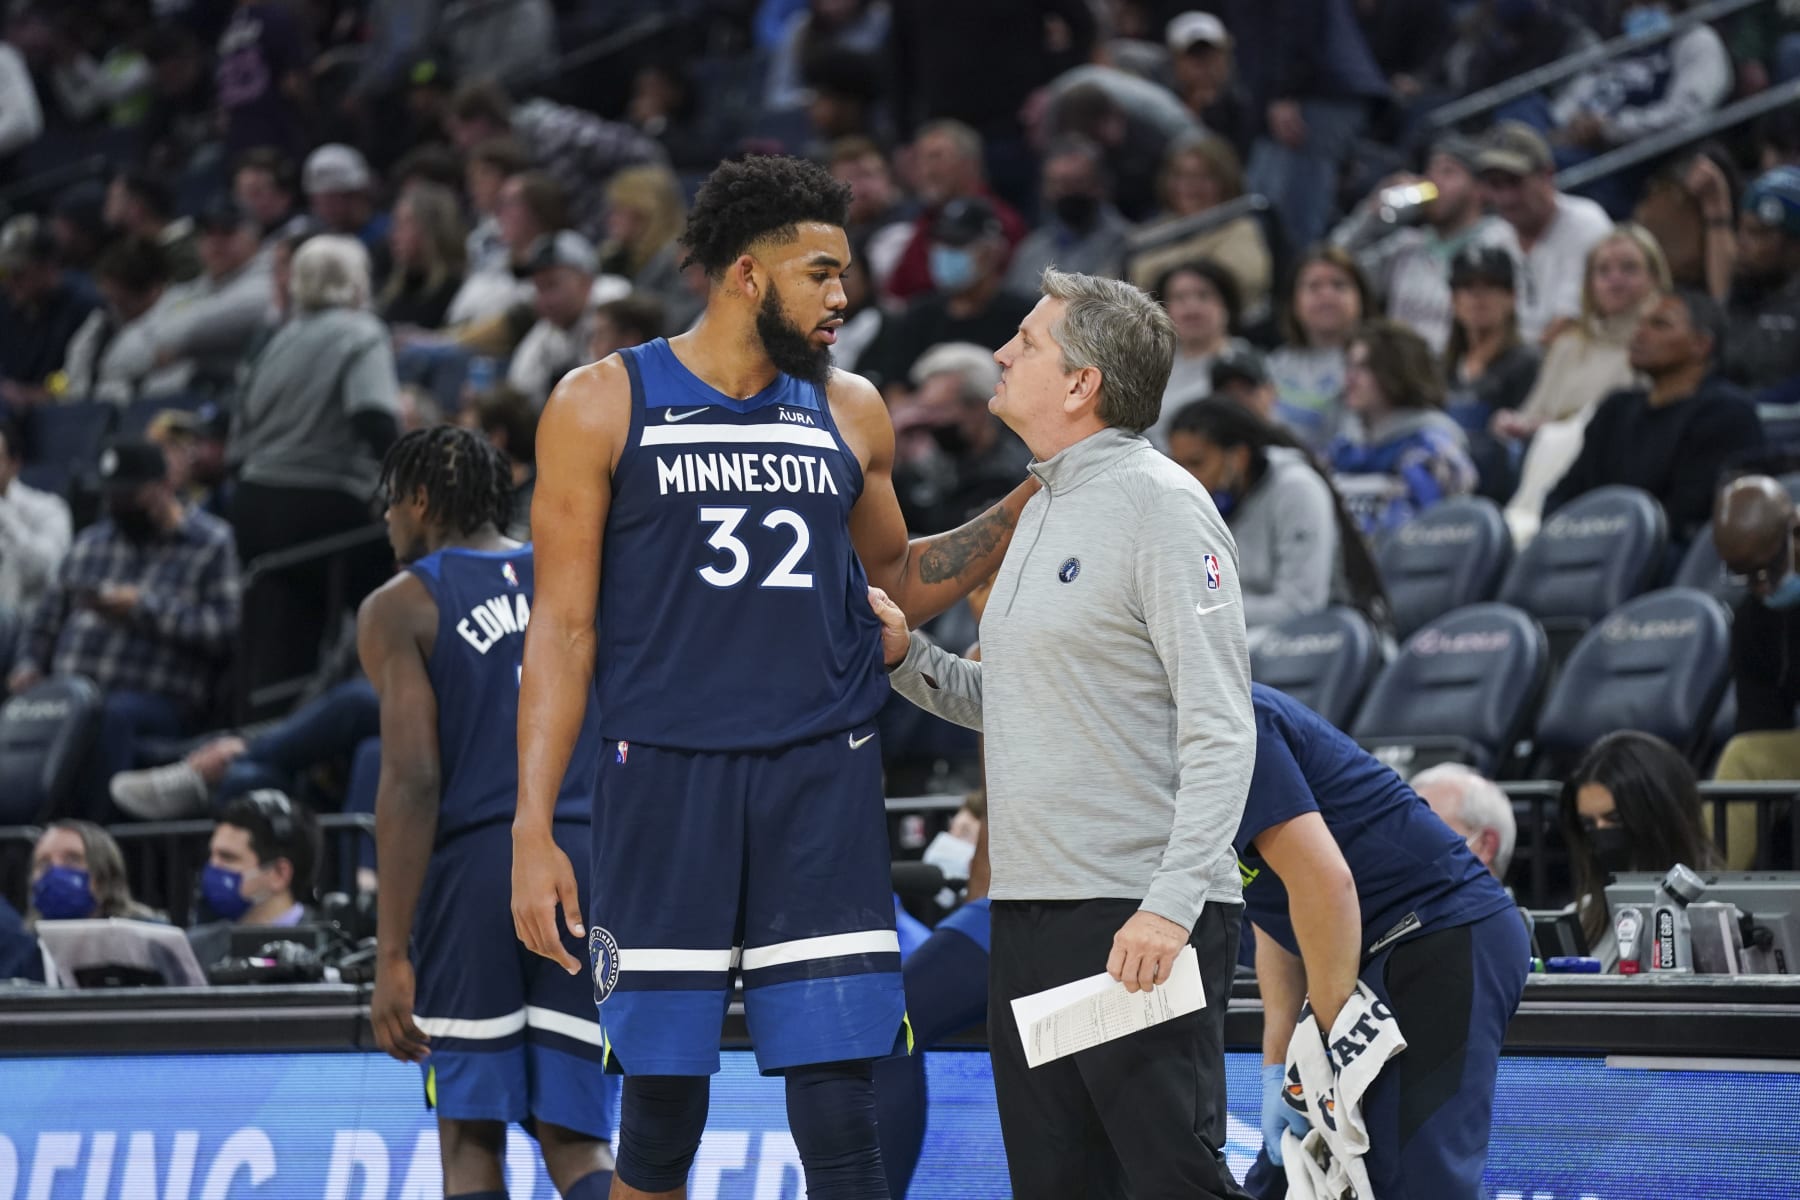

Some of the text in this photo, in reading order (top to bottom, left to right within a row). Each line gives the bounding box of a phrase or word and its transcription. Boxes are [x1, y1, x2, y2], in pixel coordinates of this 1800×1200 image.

[656, 453, 839, 496] MINNESOTA
[698, 506, 814, 589] 32
[1331, 1000, 1395, 1069] ATO
